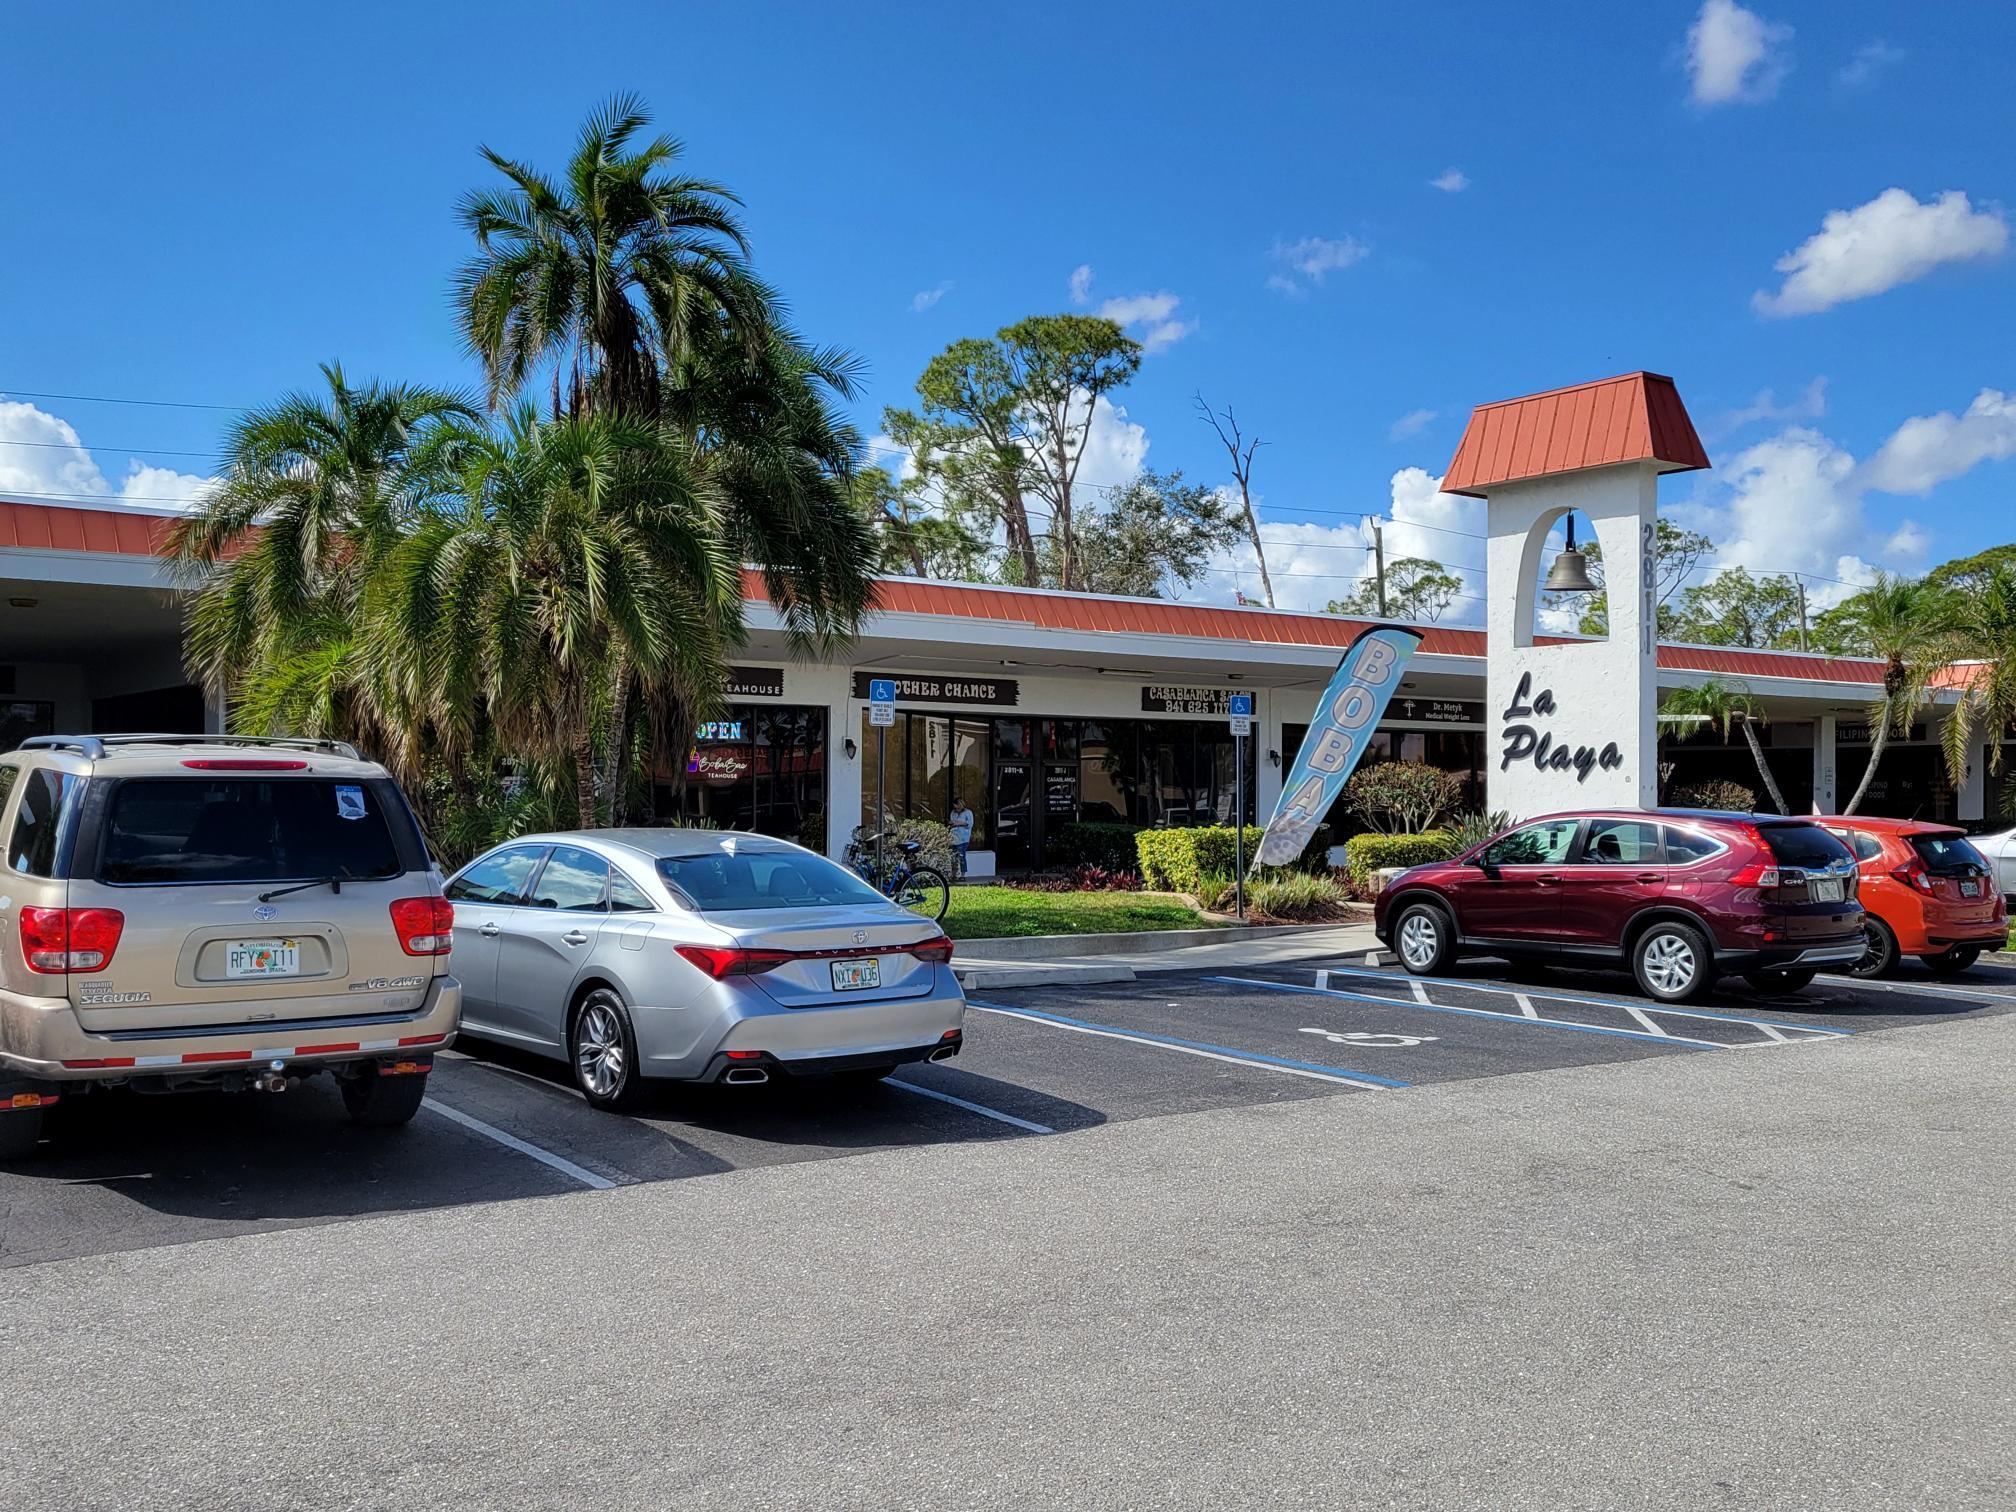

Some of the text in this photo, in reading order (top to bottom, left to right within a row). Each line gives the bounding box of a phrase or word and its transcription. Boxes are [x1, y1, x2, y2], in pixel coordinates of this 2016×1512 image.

[1642, 523, 1654, 655] 2811
[895, 680, 996, 699] OTHER CHANCE
[1149, 686, 1215, 702] CASABLANCA
[1502, 671, 1556, 722] La
[1165, 700, 1230, 714] 941 625 117
[1433, 702, 1463, 713] Dr. Metyk
[1444, 713, 1460, 721] Weight
[695, 721, 742, 739] OPEN
[1285, 637, 1397, 817] BOBA
[1835, 728, 1868, 740] FILIPIN
[1500, 724, 1623, 785] Playa
[815, 945, 902, 955] AVALON
[231, 950, 256, 969] RFY
[367, 977, 388, 989] V8
[390, 976, 425, 987] 4WD
[80, 987, 113, 995] TOYOTA
[80, 992, 151, 1004] SEQUOIA
